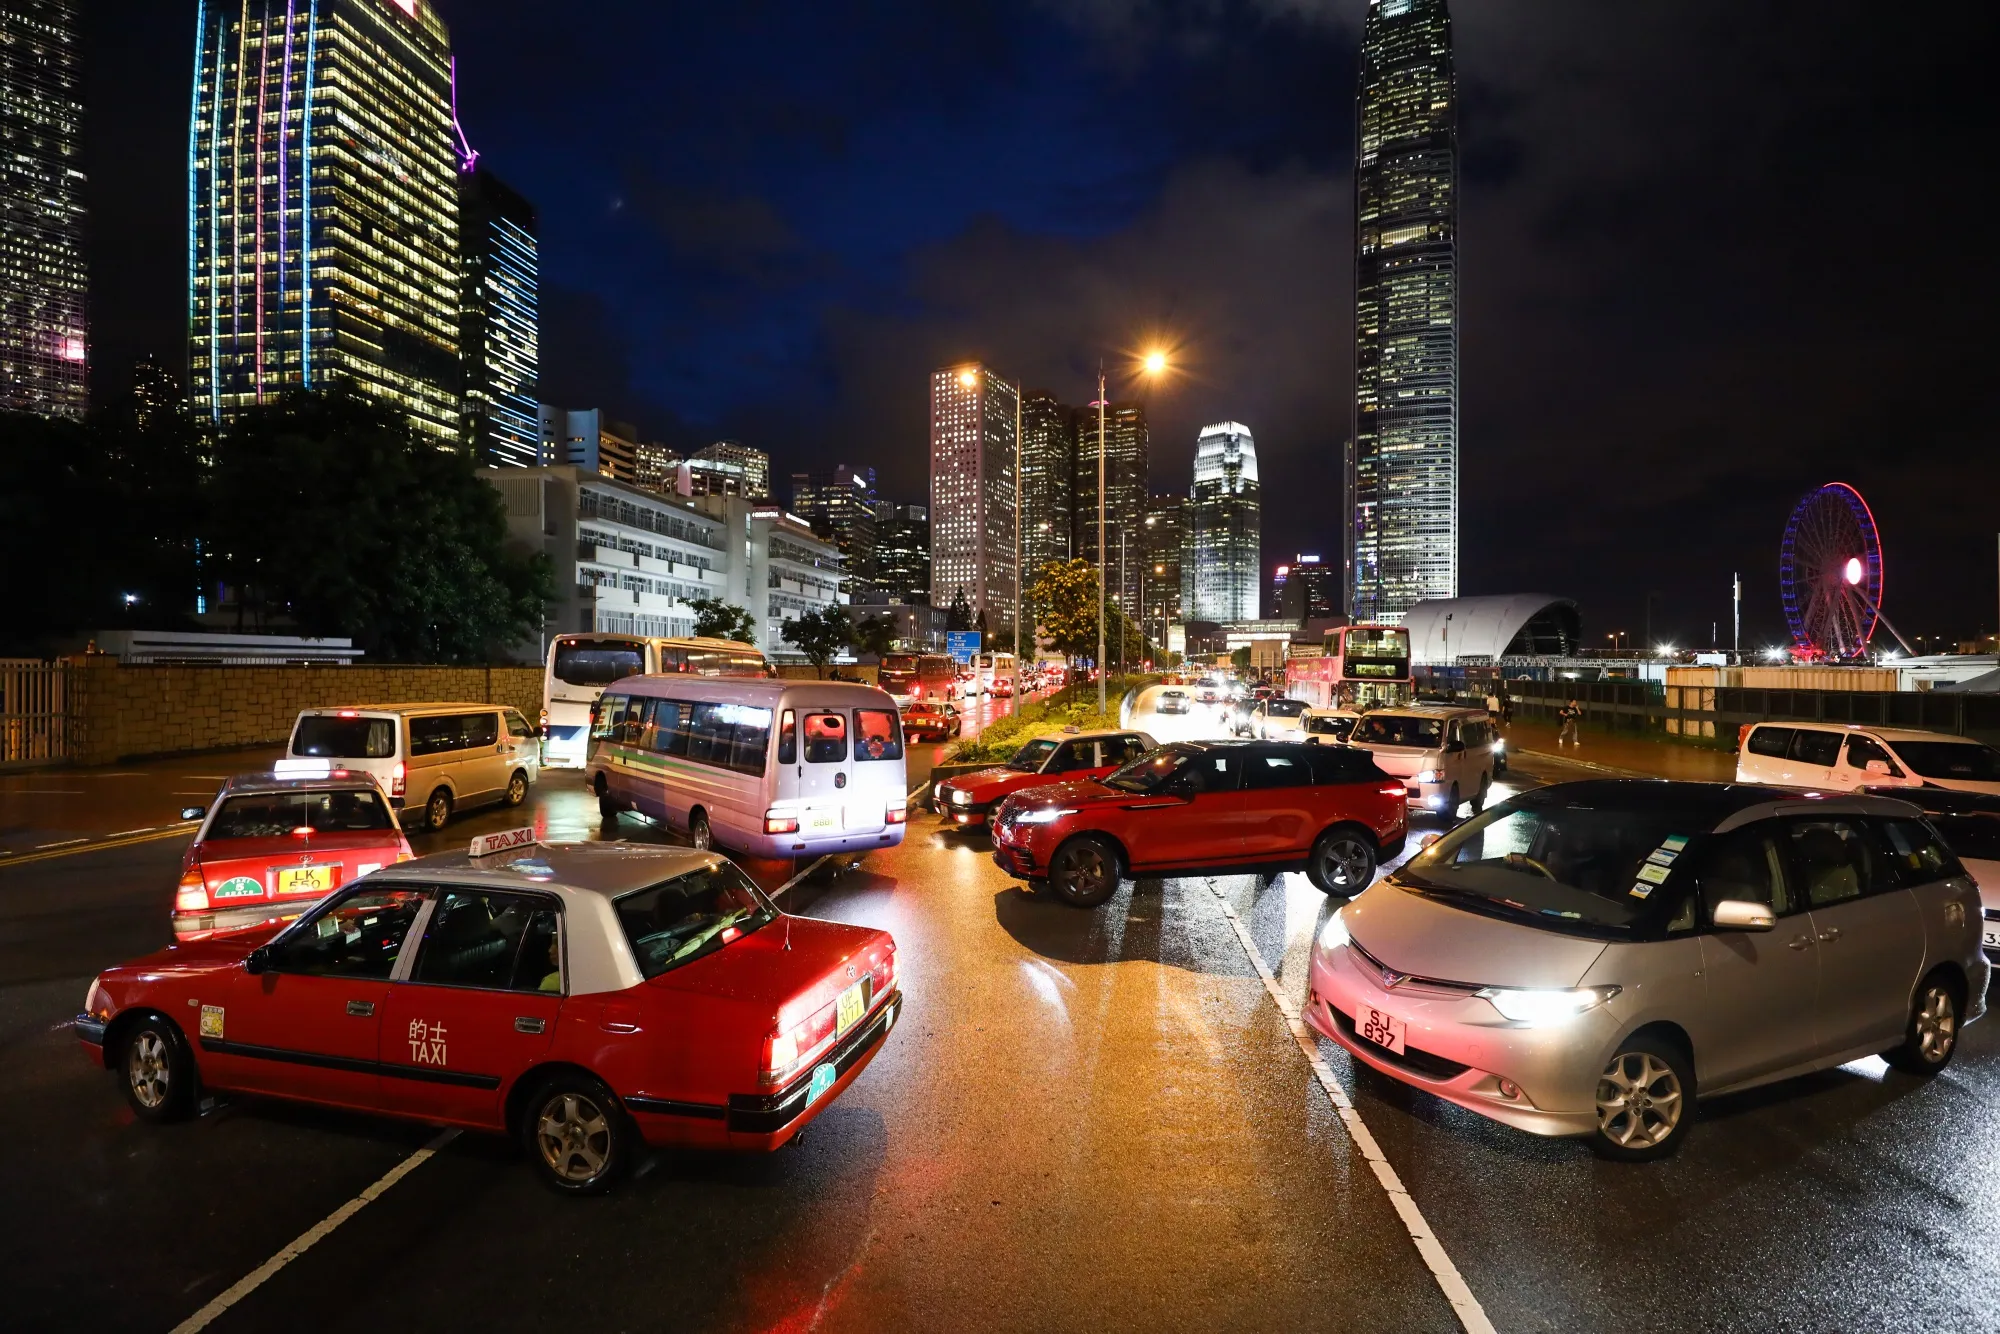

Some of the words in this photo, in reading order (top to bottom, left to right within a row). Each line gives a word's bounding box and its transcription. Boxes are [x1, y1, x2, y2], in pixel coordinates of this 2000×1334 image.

[486, 828, 532, 850] TAXI
[289, 879, 321, 892] 550
[295, 869, 315, 881] LK
[235, 883, 245, 891] 5
[1984, 932, 2000, 946] 3
[408, 1018, 447, 1043] 的士
[1370, 1010, 1391, 1031] SJ
[1364, 1022, 1396, 1048] 837
[408, 1040, 447, 1066] TAXI
